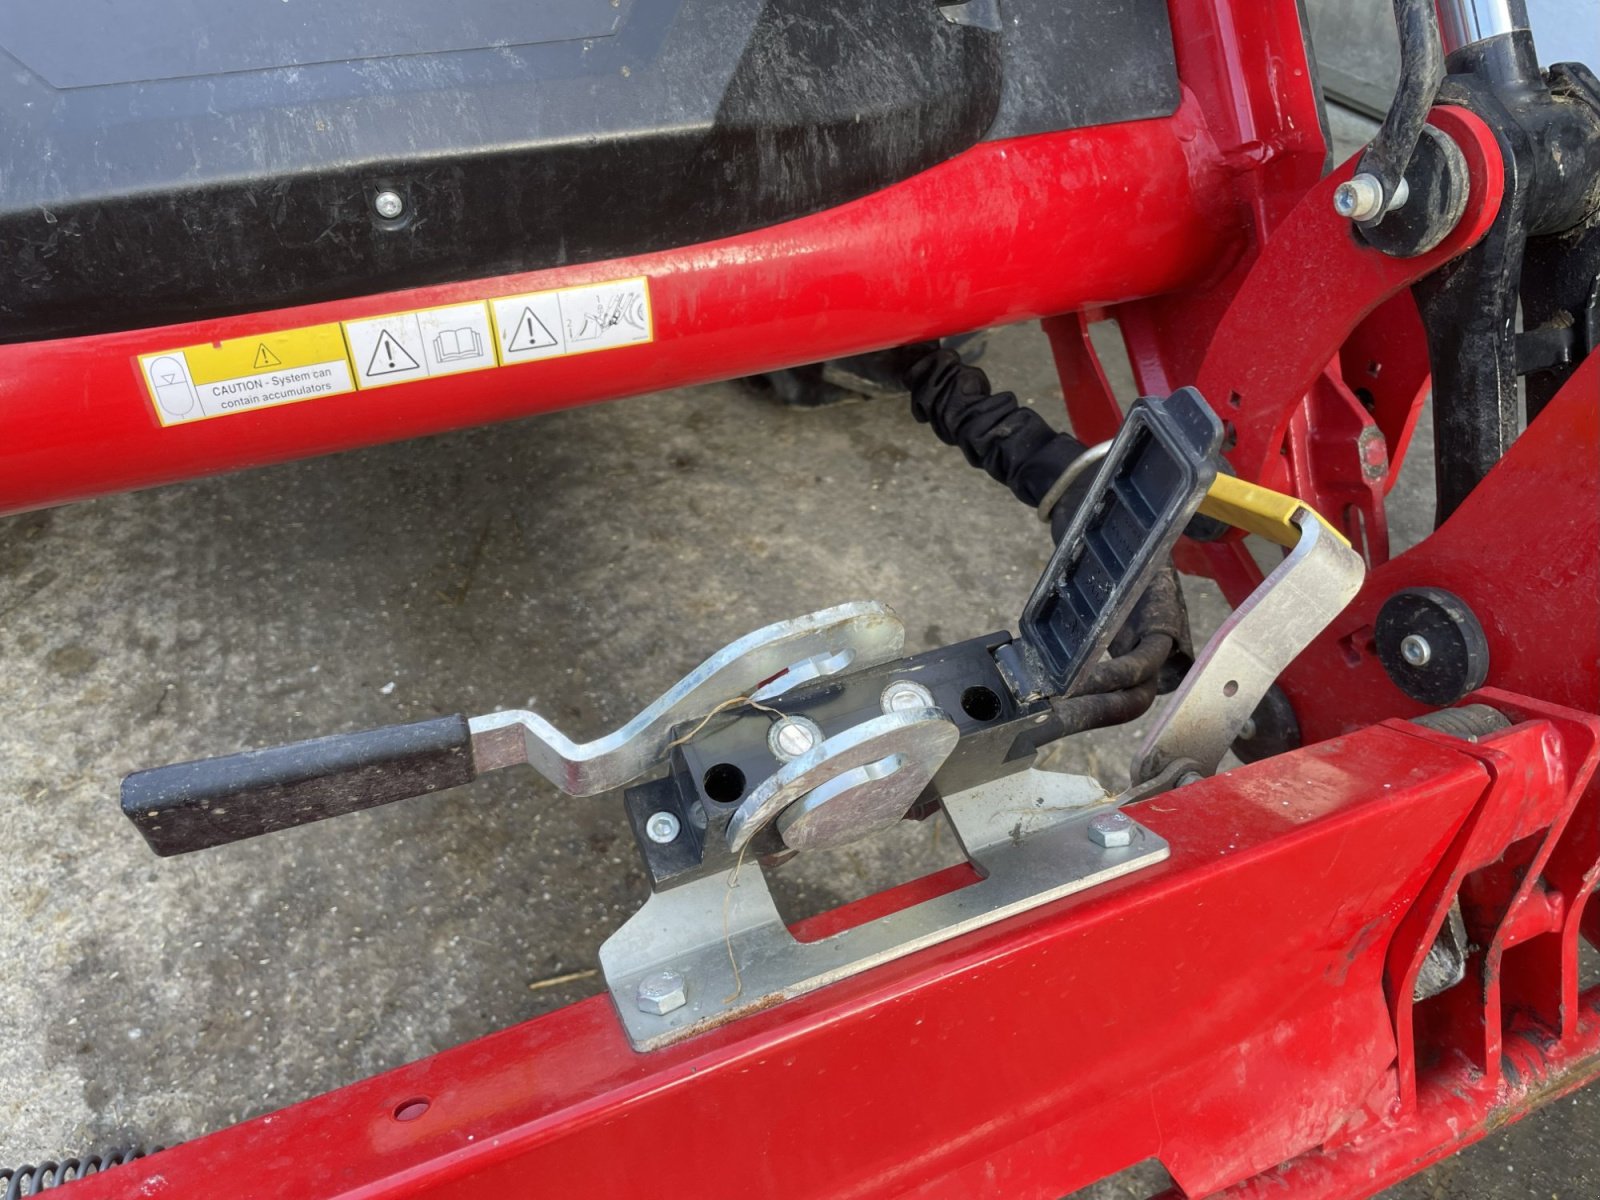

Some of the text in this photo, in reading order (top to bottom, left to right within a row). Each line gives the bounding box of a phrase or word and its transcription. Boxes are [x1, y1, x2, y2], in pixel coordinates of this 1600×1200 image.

[212, 379, 263, 397] CAUTION
[271, 372, 311, 387] System
[312, 368, 332, 379] can
[220, 382, 332, 409] contain accumulators
